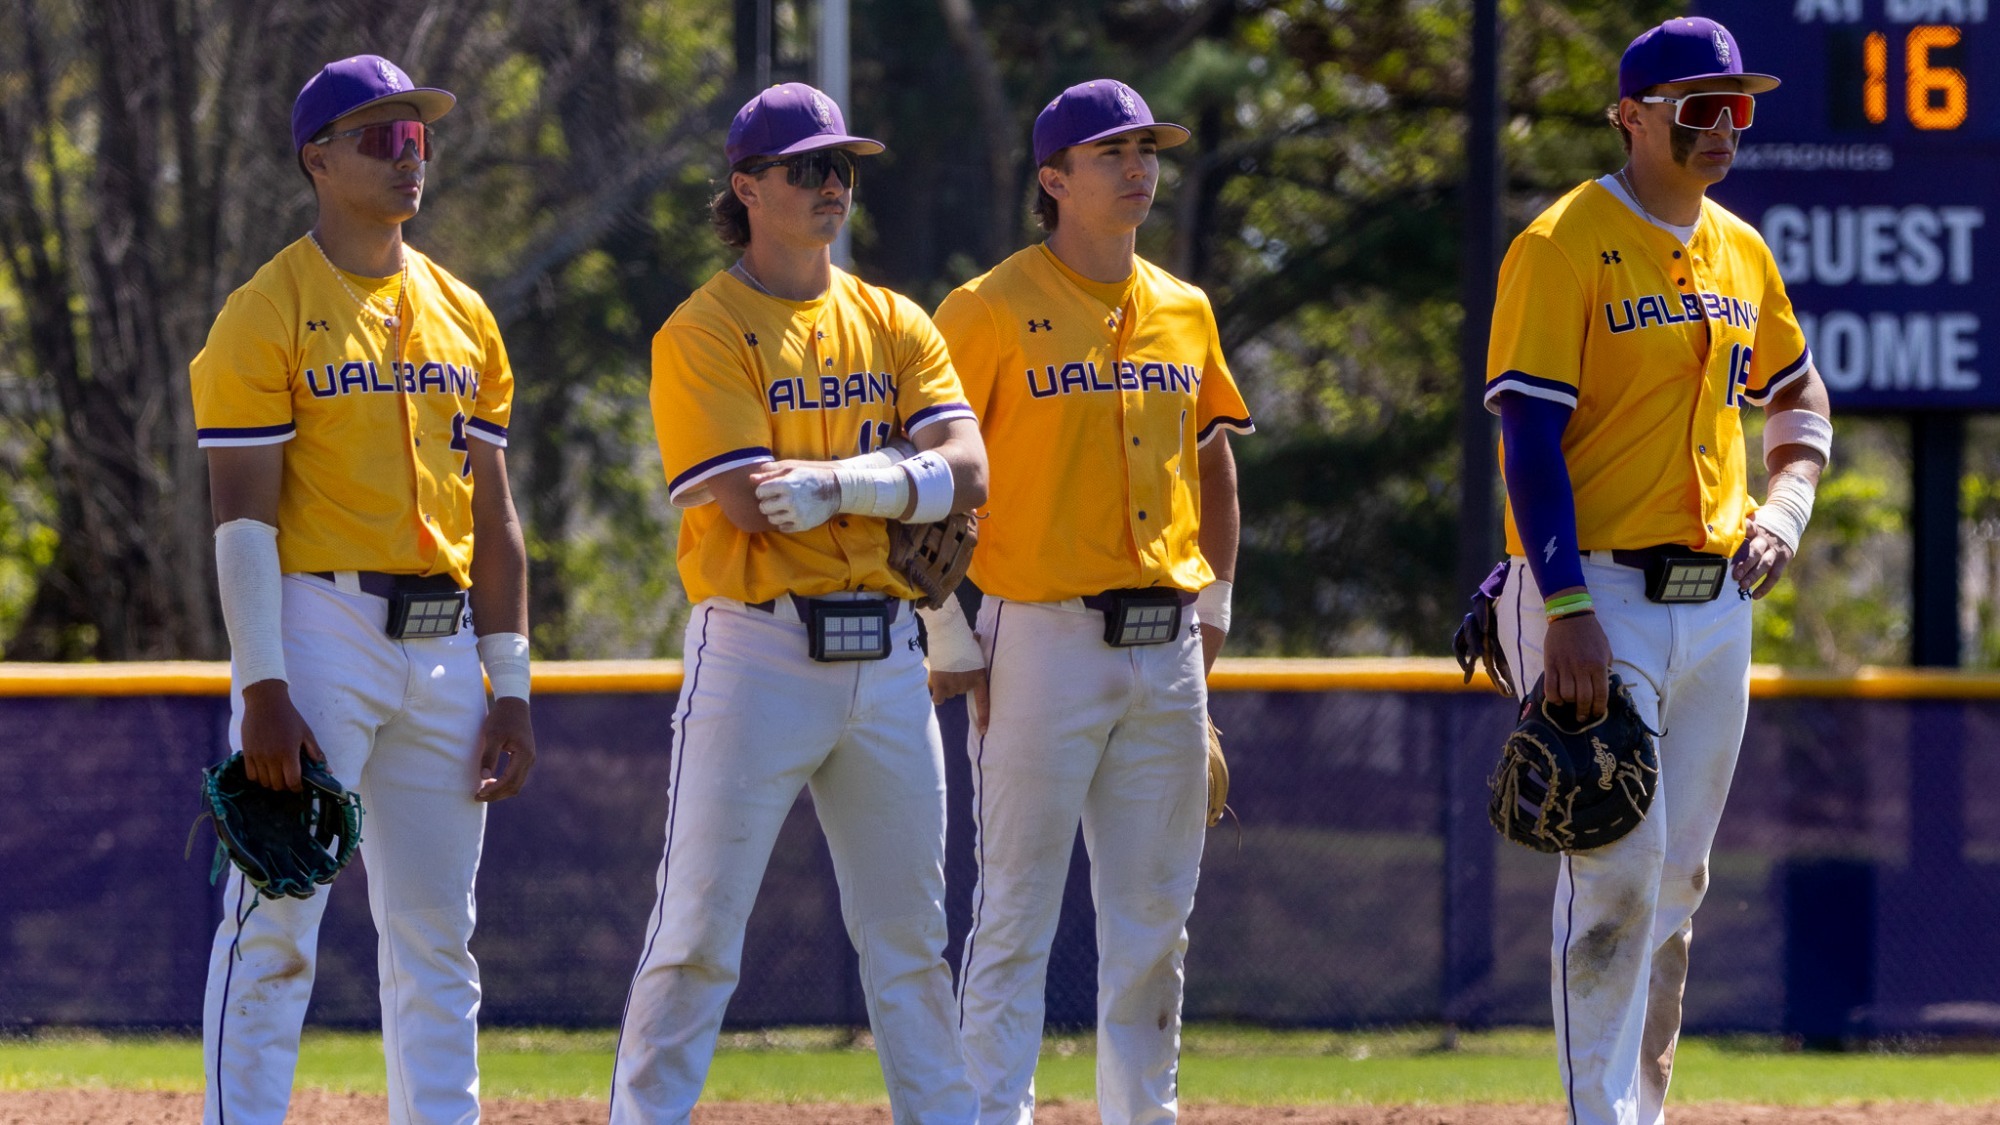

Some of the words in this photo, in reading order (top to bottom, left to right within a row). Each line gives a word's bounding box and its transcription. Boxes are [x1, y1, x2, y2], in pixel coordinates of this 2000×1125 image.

[1863, 25, 1967, 130] 16
[1762, 206, 1984, 285] GUEST
[305, 361, 480, 401] UALBANY
[1025, 361, 1202, 399] UALBANY
